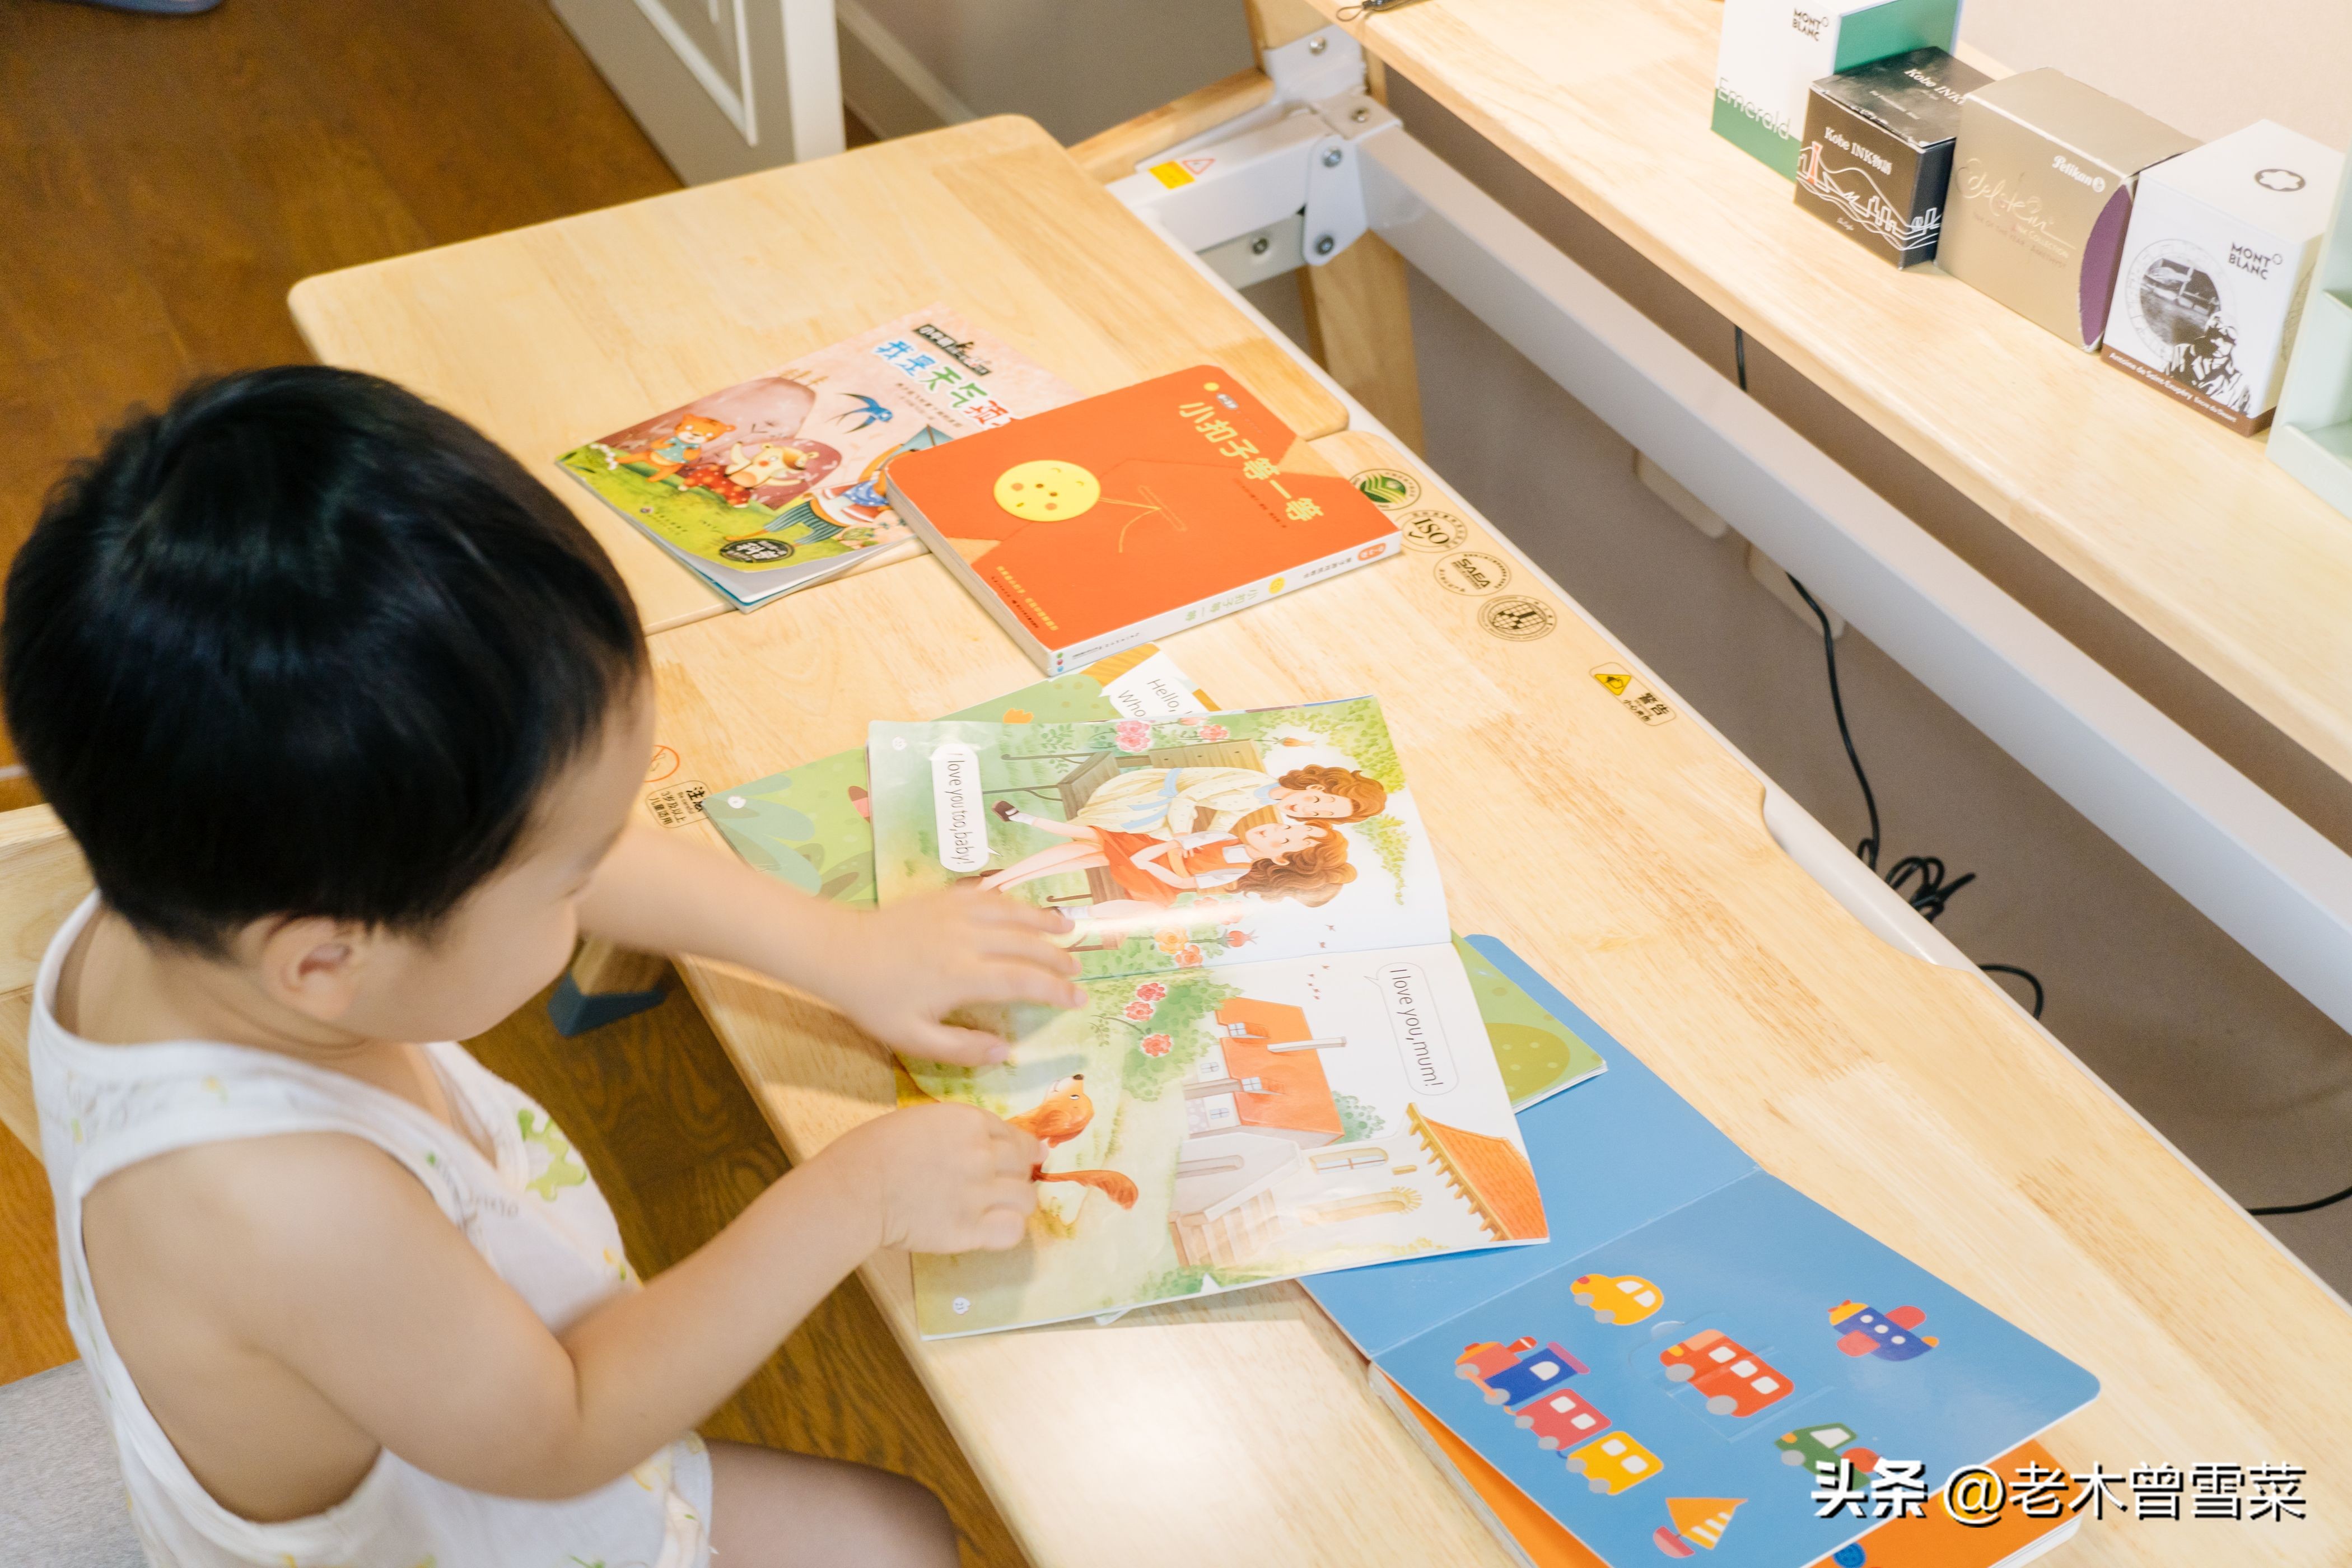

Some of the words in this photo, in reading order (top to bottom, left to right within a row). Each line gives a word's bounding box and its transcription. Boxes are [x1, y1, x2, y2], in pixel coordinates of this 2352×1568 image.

[1792, 18, 1819, 41] BLANC
[1794, 8, 1821, 30] MONT
[1905, 68, 1936, 87] Kobe
[1716, 77, 1791, 140] Emerald
[1824, 127, 1850, 151] Kobe
[2052, 155, 2093, 186] Pelikan
[2229, 253, 2269, 280] BLANC
[2231, 242, 2271, 268] MONT
[874, 340, 1010, 426] 我是天气预
[1179, 402, 1324, 521] 小扣子等一等
[1412, 518, 1450, 544] ISO
[1457, 558, 1491, 587] SAEA
[1118, 689, 1146, 717] Who
[1147, 678, 1180, 712] Hello,
[1638, 693, 1670, 716] 警告
[947, 760, 965, 786] love
[660, 790, 687, 824] 3岁及以上
[944, 788, 965, 809] you
[1392, 975, 1413, 1005] love
